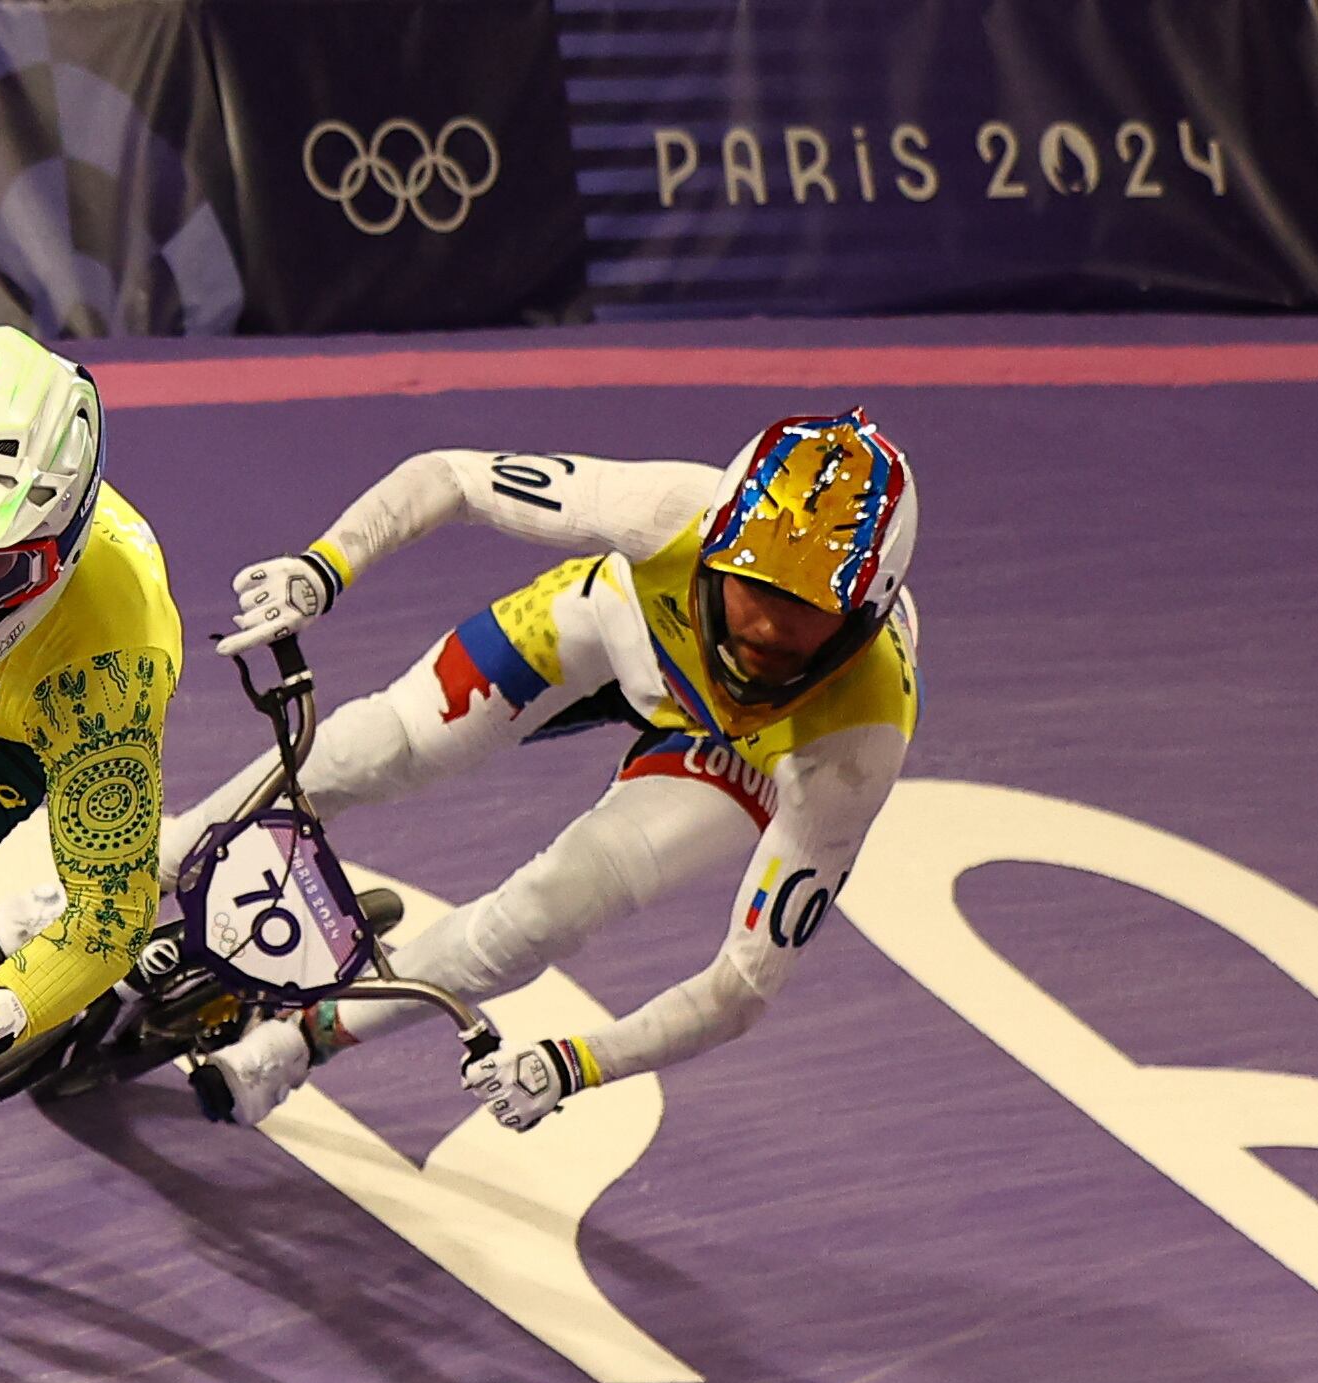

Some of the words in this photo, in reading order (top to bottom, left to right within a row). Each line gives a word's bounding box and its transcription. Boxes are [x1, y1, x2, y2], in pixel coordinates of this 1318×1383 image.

[976, 119, 1226, 199] 2024
[233, 868, 302, 957] 70
[312, 897, 341, 941] 2024
